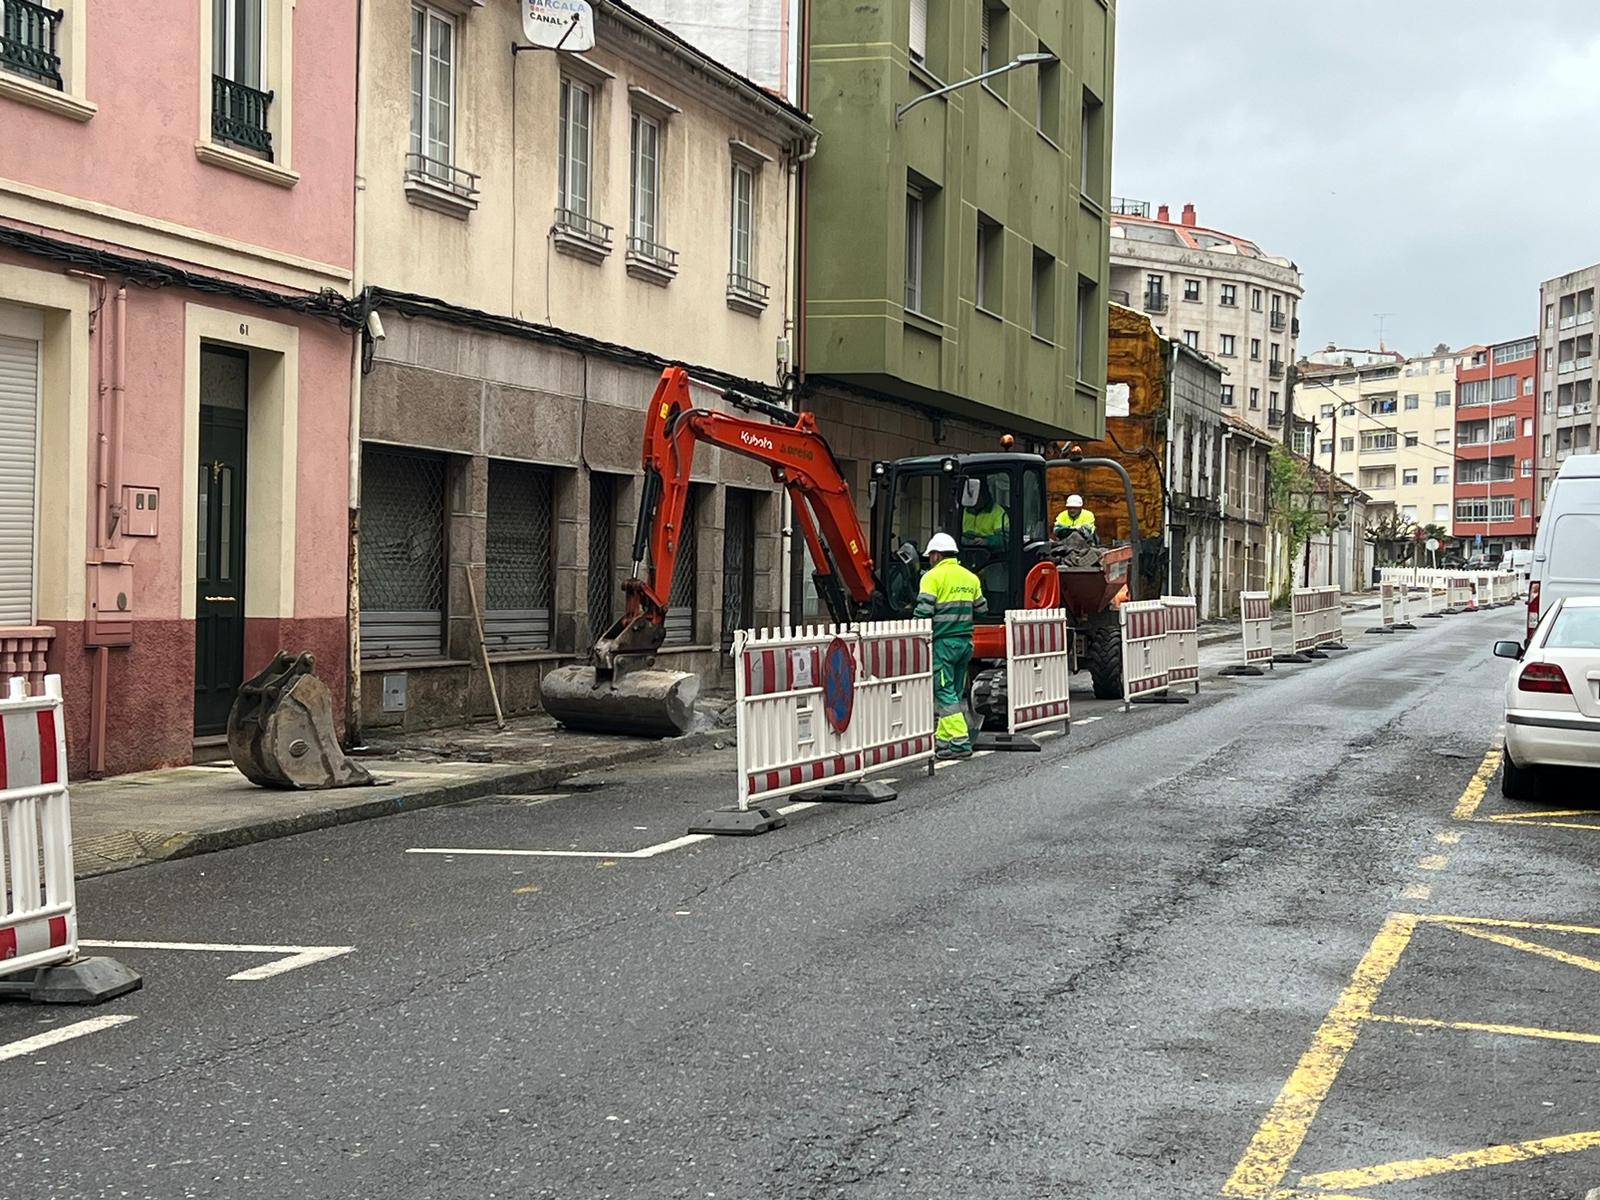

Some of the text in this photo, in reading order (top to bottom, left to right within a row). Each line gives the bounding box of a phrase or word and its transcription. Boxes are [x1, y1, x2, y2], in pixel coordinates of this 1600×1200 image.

[529, 12, 568, 26] CANAL+
[239, 323, 249, 336] 61
[740, 430, 773, 450] Kubota
